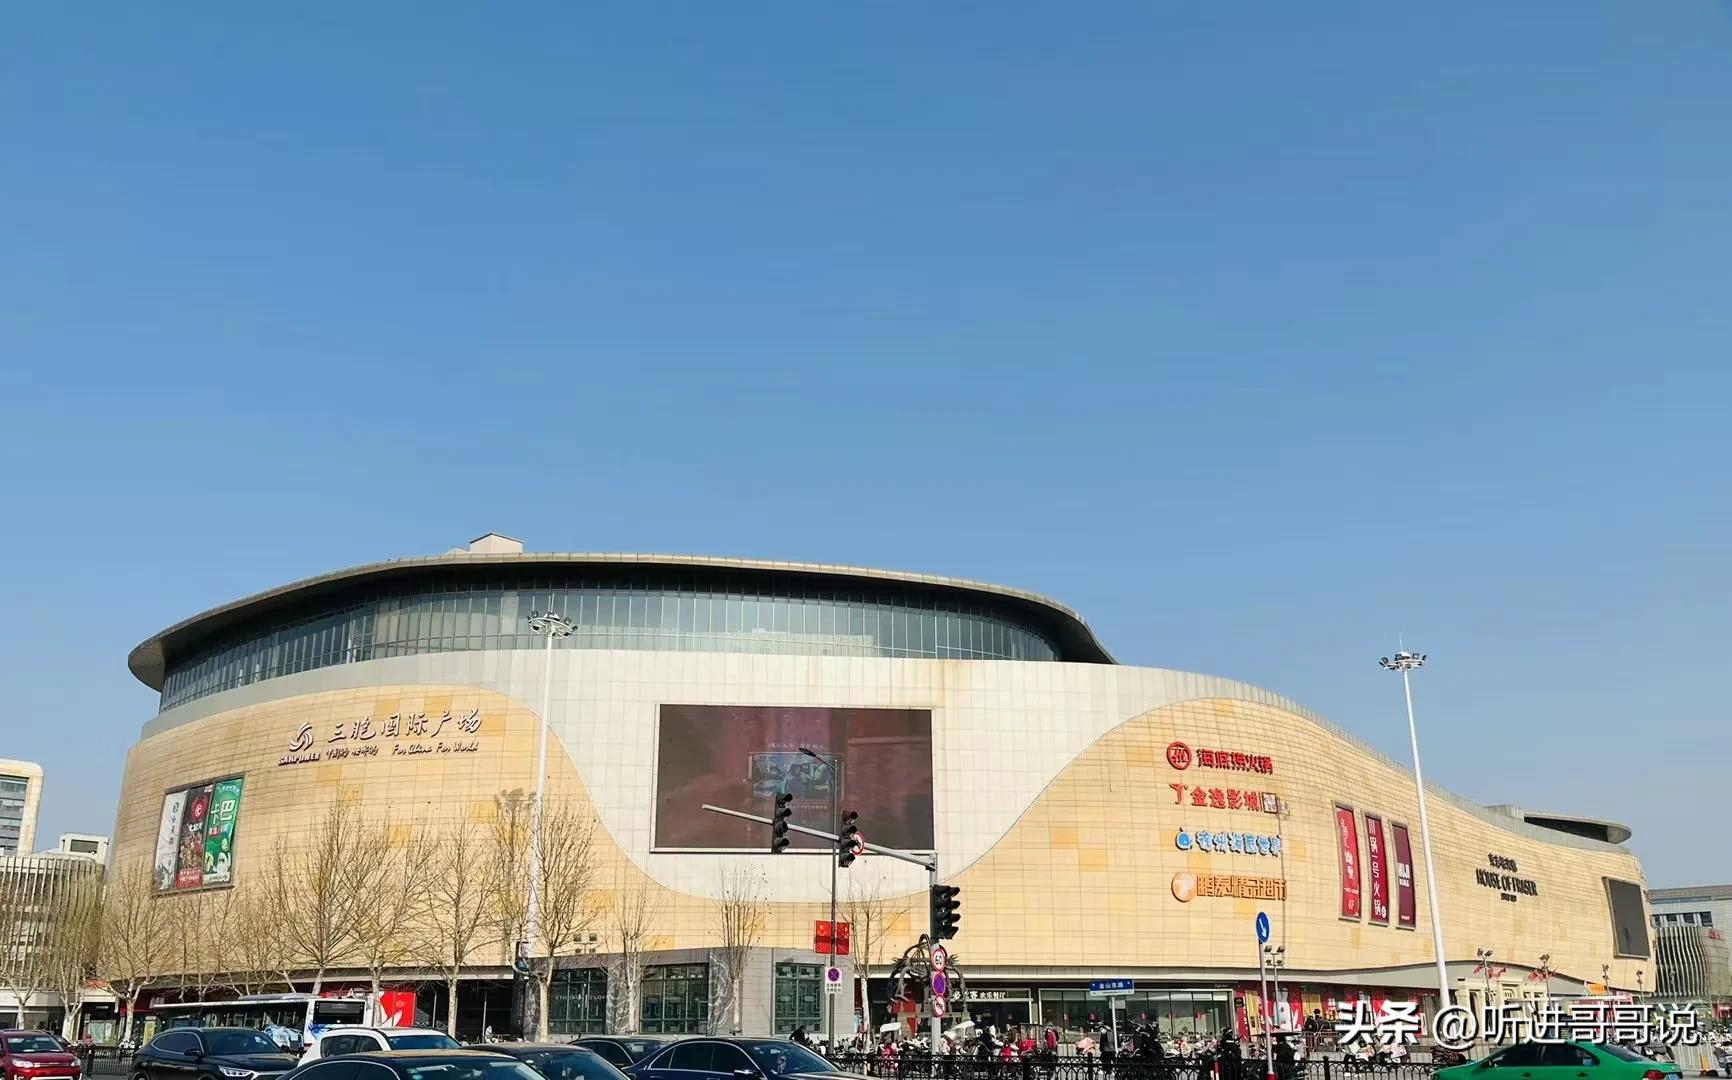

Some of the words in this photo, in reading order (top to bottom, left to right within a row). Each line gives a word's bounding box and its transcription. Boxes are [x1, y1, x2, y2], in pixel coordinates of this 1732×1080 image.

[328, 707, 482, 743] 三胞国际广场
[278, 752, 321, 766] SANPOWER
[1196, 749, 1273, 775] 海底捞火锅
[1190, 785, 1260, 811] 金逸影城
[1476, 868, 1501, 890] HOUSE
[1501, 875, 1511, 891] OF
[1511, 877, 1538, 896] FRASER
